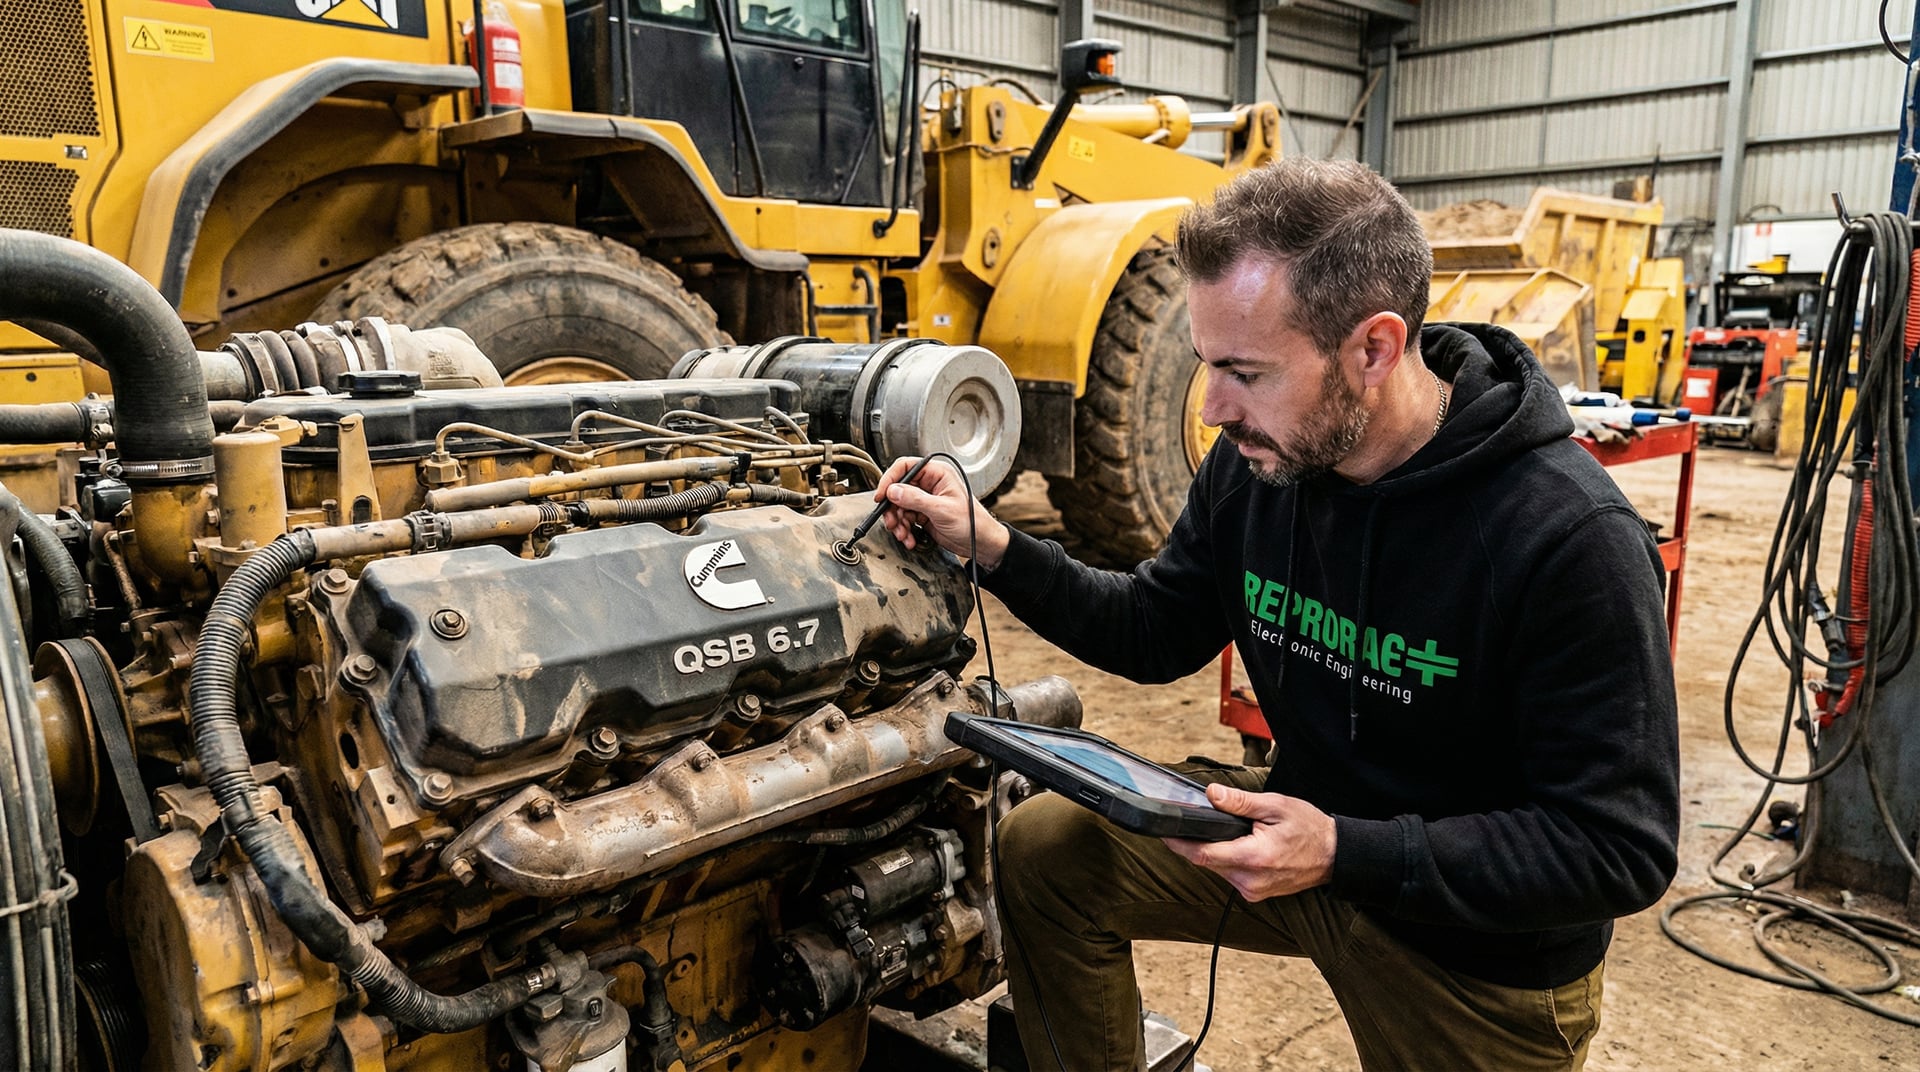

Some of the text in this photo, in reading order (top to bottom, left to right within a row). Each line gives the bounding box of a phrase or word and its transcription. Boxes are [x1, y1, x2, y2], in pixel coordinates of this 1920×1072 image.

[164, 28, 206, 39] WARNING
[690, 540, 732, 588] Cummins
[674, 618, 820, 674] QSB 6.7
[1251, 619, 1412, 704] Electonic Engieering
